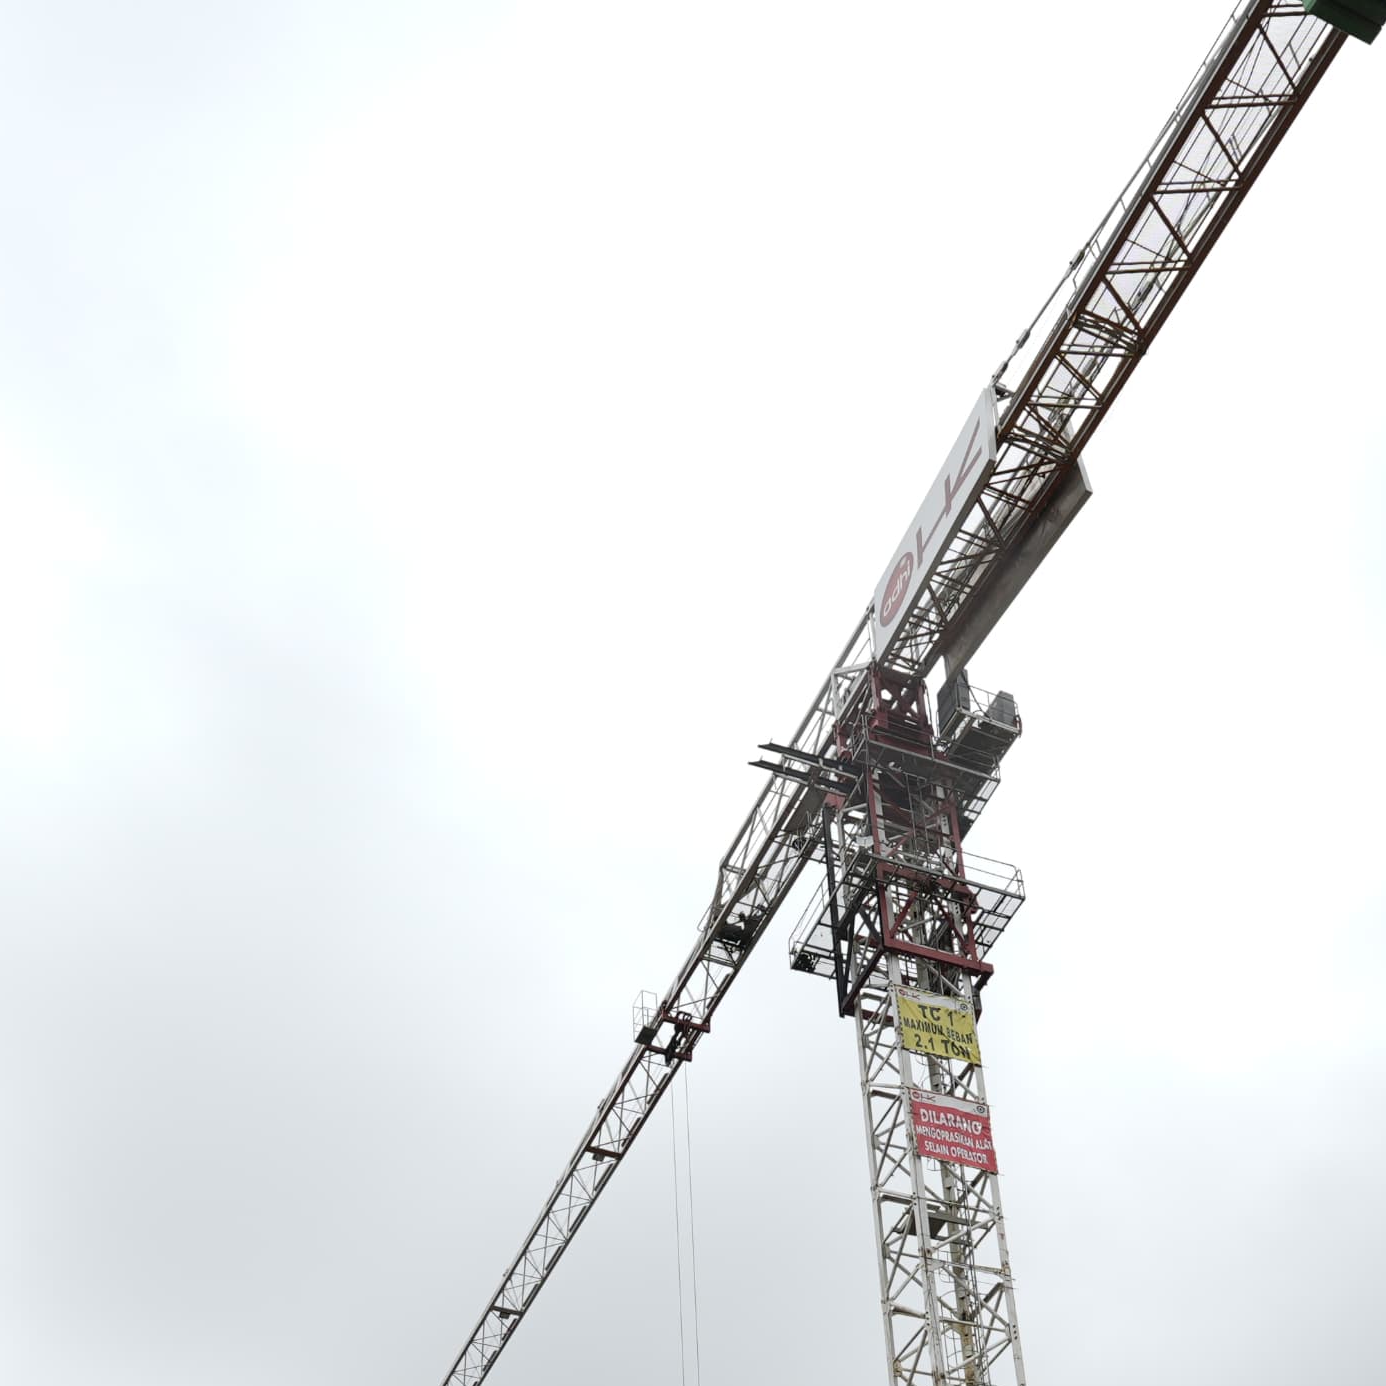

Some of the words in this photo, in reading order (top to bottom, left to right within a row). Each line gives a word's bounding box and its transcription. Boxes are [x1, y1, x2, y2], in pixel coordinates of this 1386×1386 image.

[918, 1005, 941, 1021] TC
[903, 1017, 943, 1035] MAXIMUM
[946, 1027, 973, 1044] BEBAN
[914, 1034, 935, 1051] 2.1
[941, 1040, 971, 1059] TON
[919, 1109, 982, 1135] DILARANG
[924, 1141, 949, 1155] SELAIN
[950, 1147, 989, 1164] OPERATOR
[975, 1139, 992, 1150] ALAT
